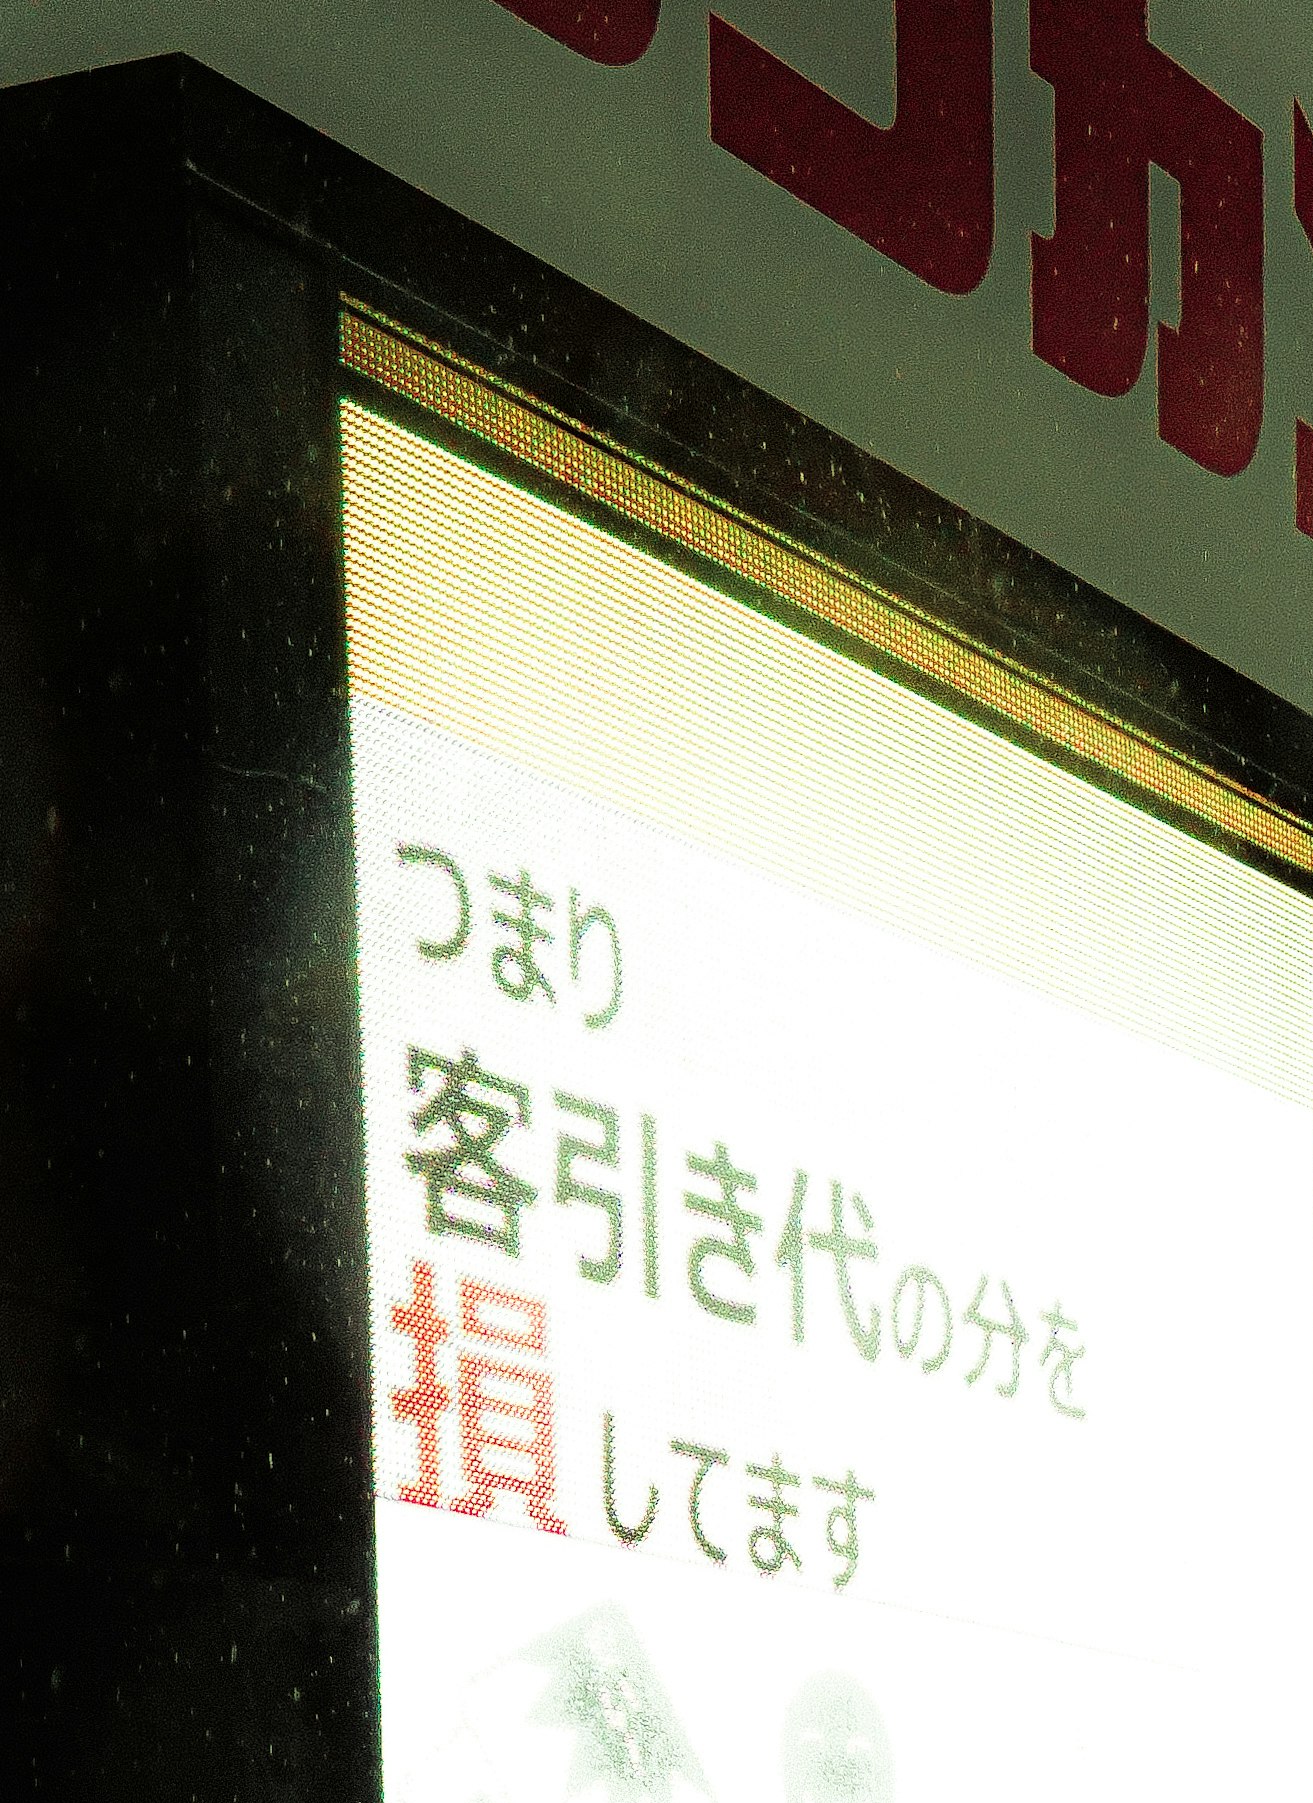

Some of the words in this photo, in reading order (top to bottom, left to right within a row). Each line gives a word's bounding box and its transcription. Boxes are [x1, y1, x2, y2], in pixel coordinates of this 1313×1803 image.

[396, 841, 626, 1030] つまり
[401, 1044, 1087, 1421] 客引き代の分を
[389, 1257, 875, 1590] 損してます
